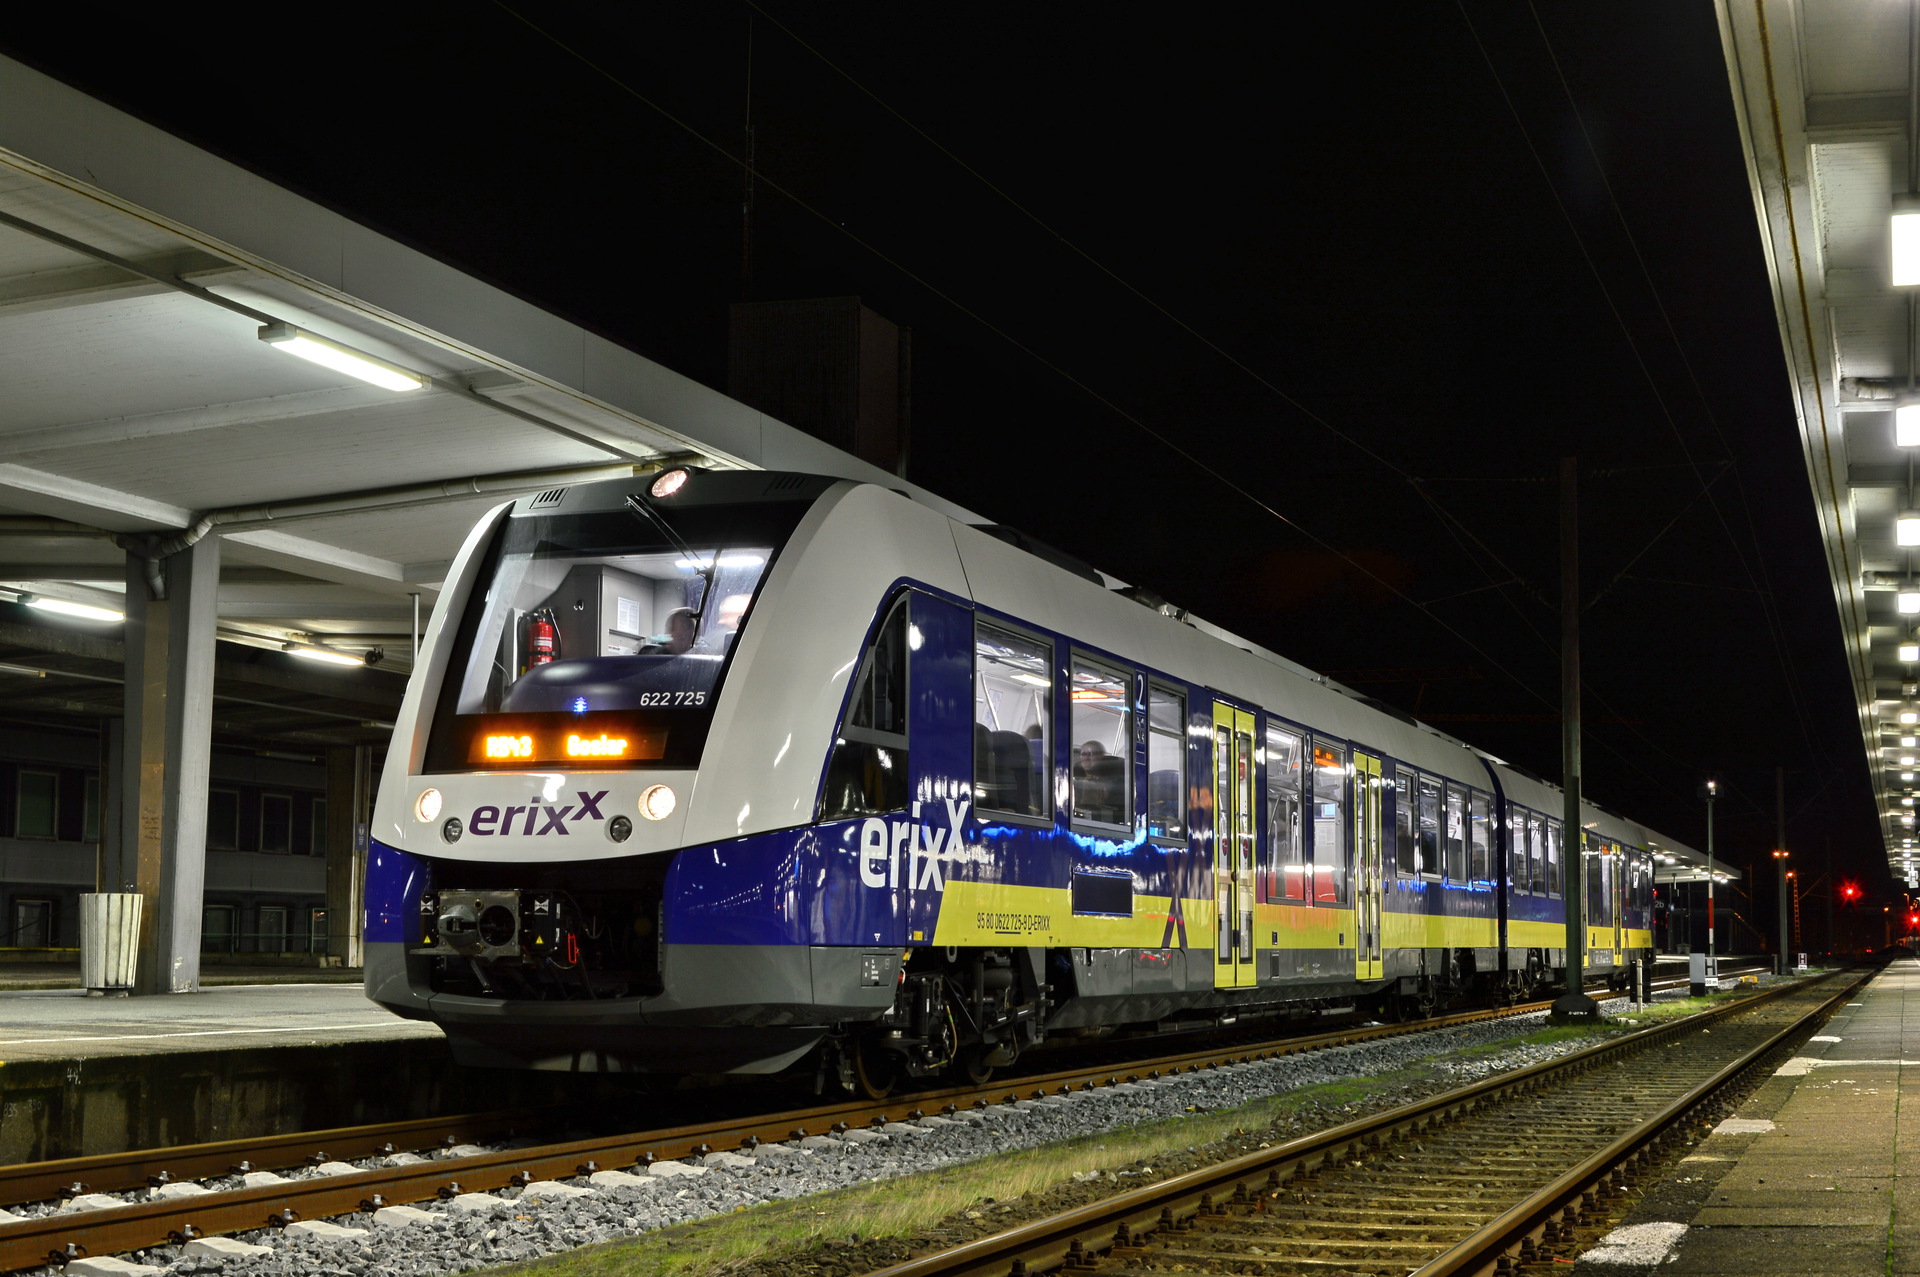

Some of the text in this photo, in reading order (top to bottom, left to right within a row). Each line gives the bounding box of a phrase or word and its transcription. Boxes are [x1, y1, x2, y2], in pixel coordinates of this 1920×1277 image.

[640, 691, 706, 707] 622 725
[1137, 674, 1144, 710] 2
[567, 734, 628, 756] Goslar
[1304, 734, 1311, 763] 2
[977, 912, 1051, 931] 95 80 0622 725-9 D-ERIXX
[1705, 958, 1716, 976] H
[1799, 953, 1806, 964] H
